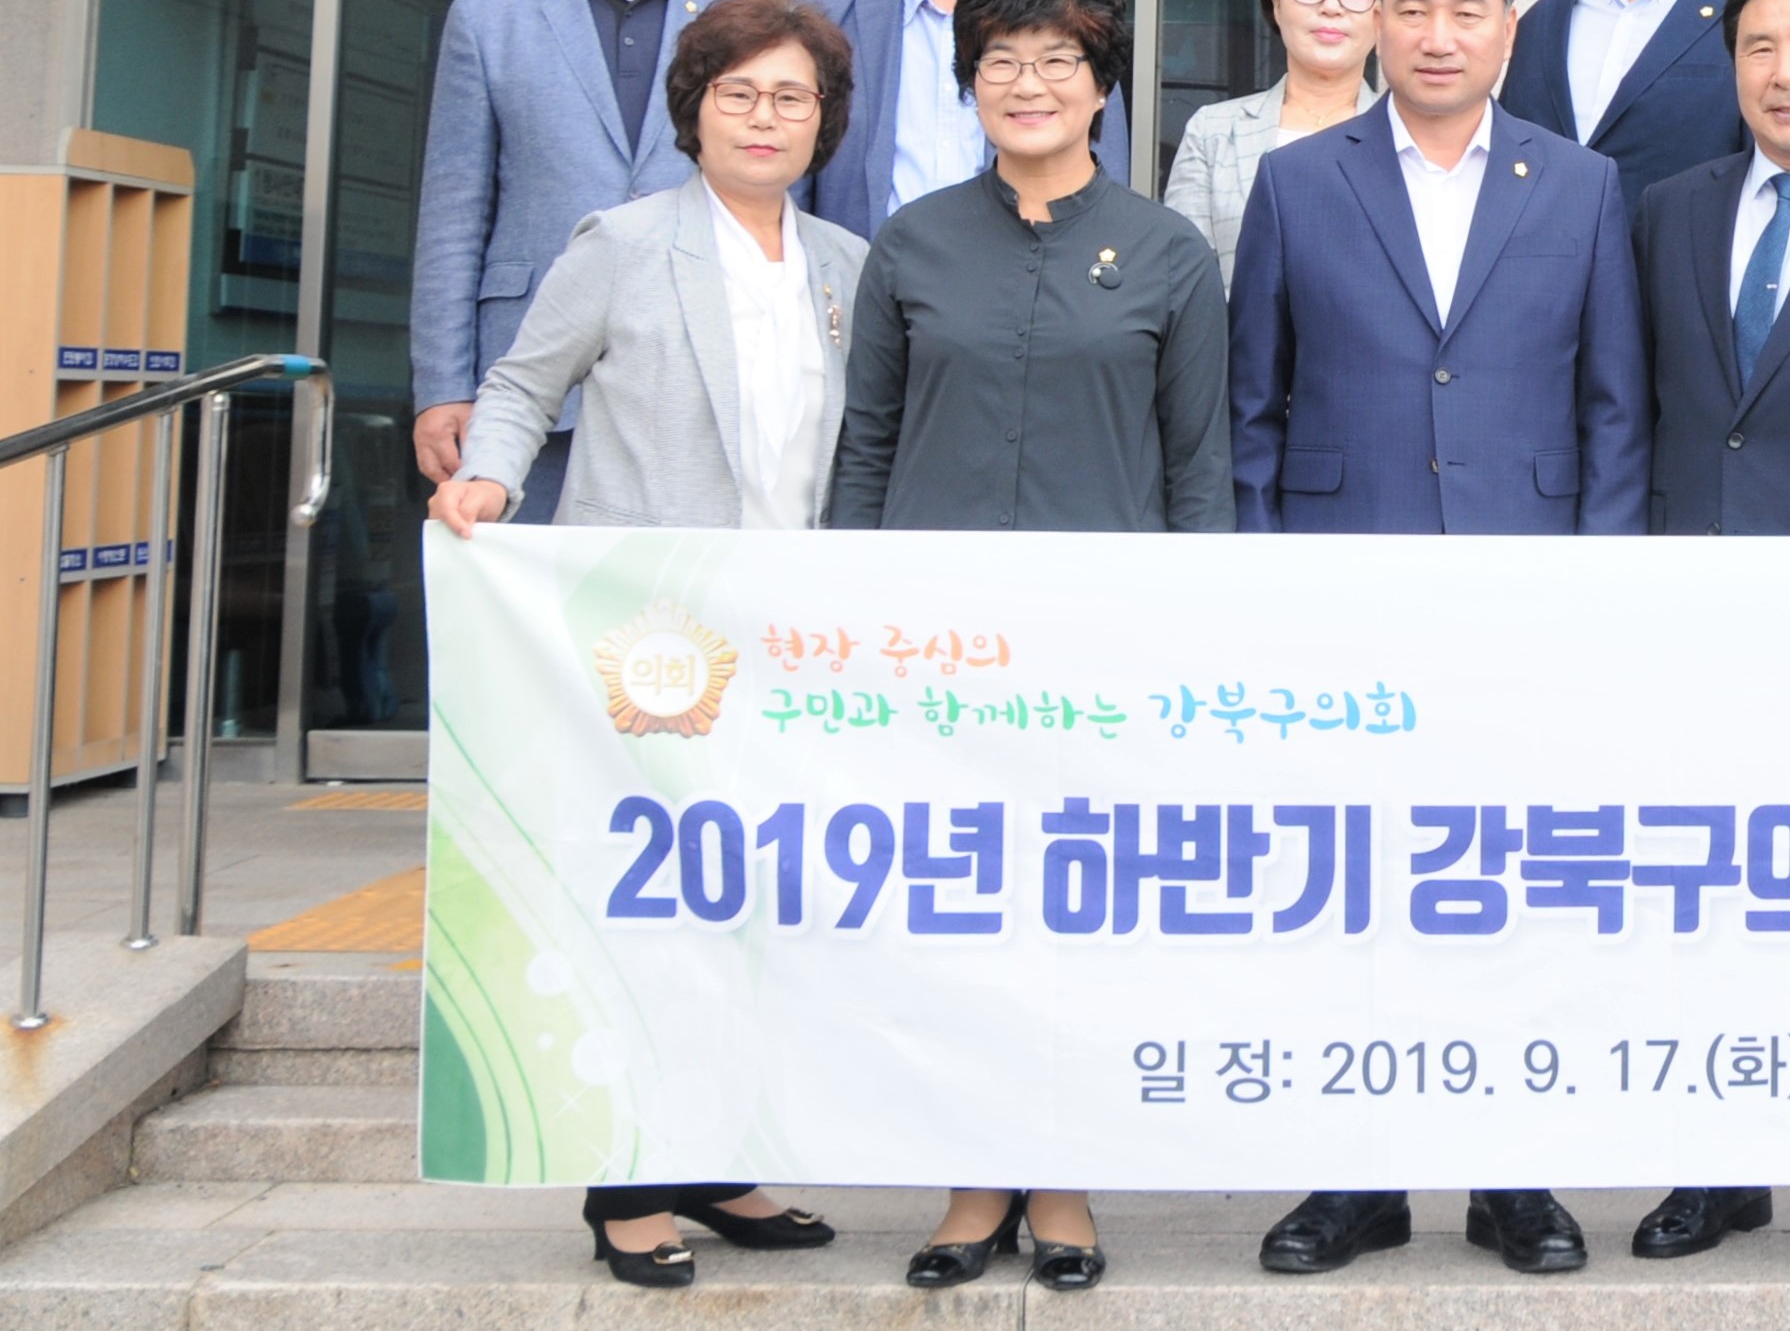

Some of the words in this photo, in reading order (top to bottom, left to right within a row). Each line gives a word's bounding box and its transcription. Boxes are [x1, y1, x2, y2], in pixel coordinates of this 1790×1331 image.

[630, 654, 696, 697] 의회
[761, 625, 859, 673] 현장
[880, 625, 1011, 678] 중심의
[762, 689, 898, 734] 구민과
[917, 686, 1127, 739] 함께하는
[1148, 681, 1416, 744] 강북구의회
[606, 796, 1004, 934] 2019년
[1042, 797, 1371, 935] 하반기
[1321, 1039, 1495, 1096] 2019.
[1523, 1039, 1576, 1095] 9.
